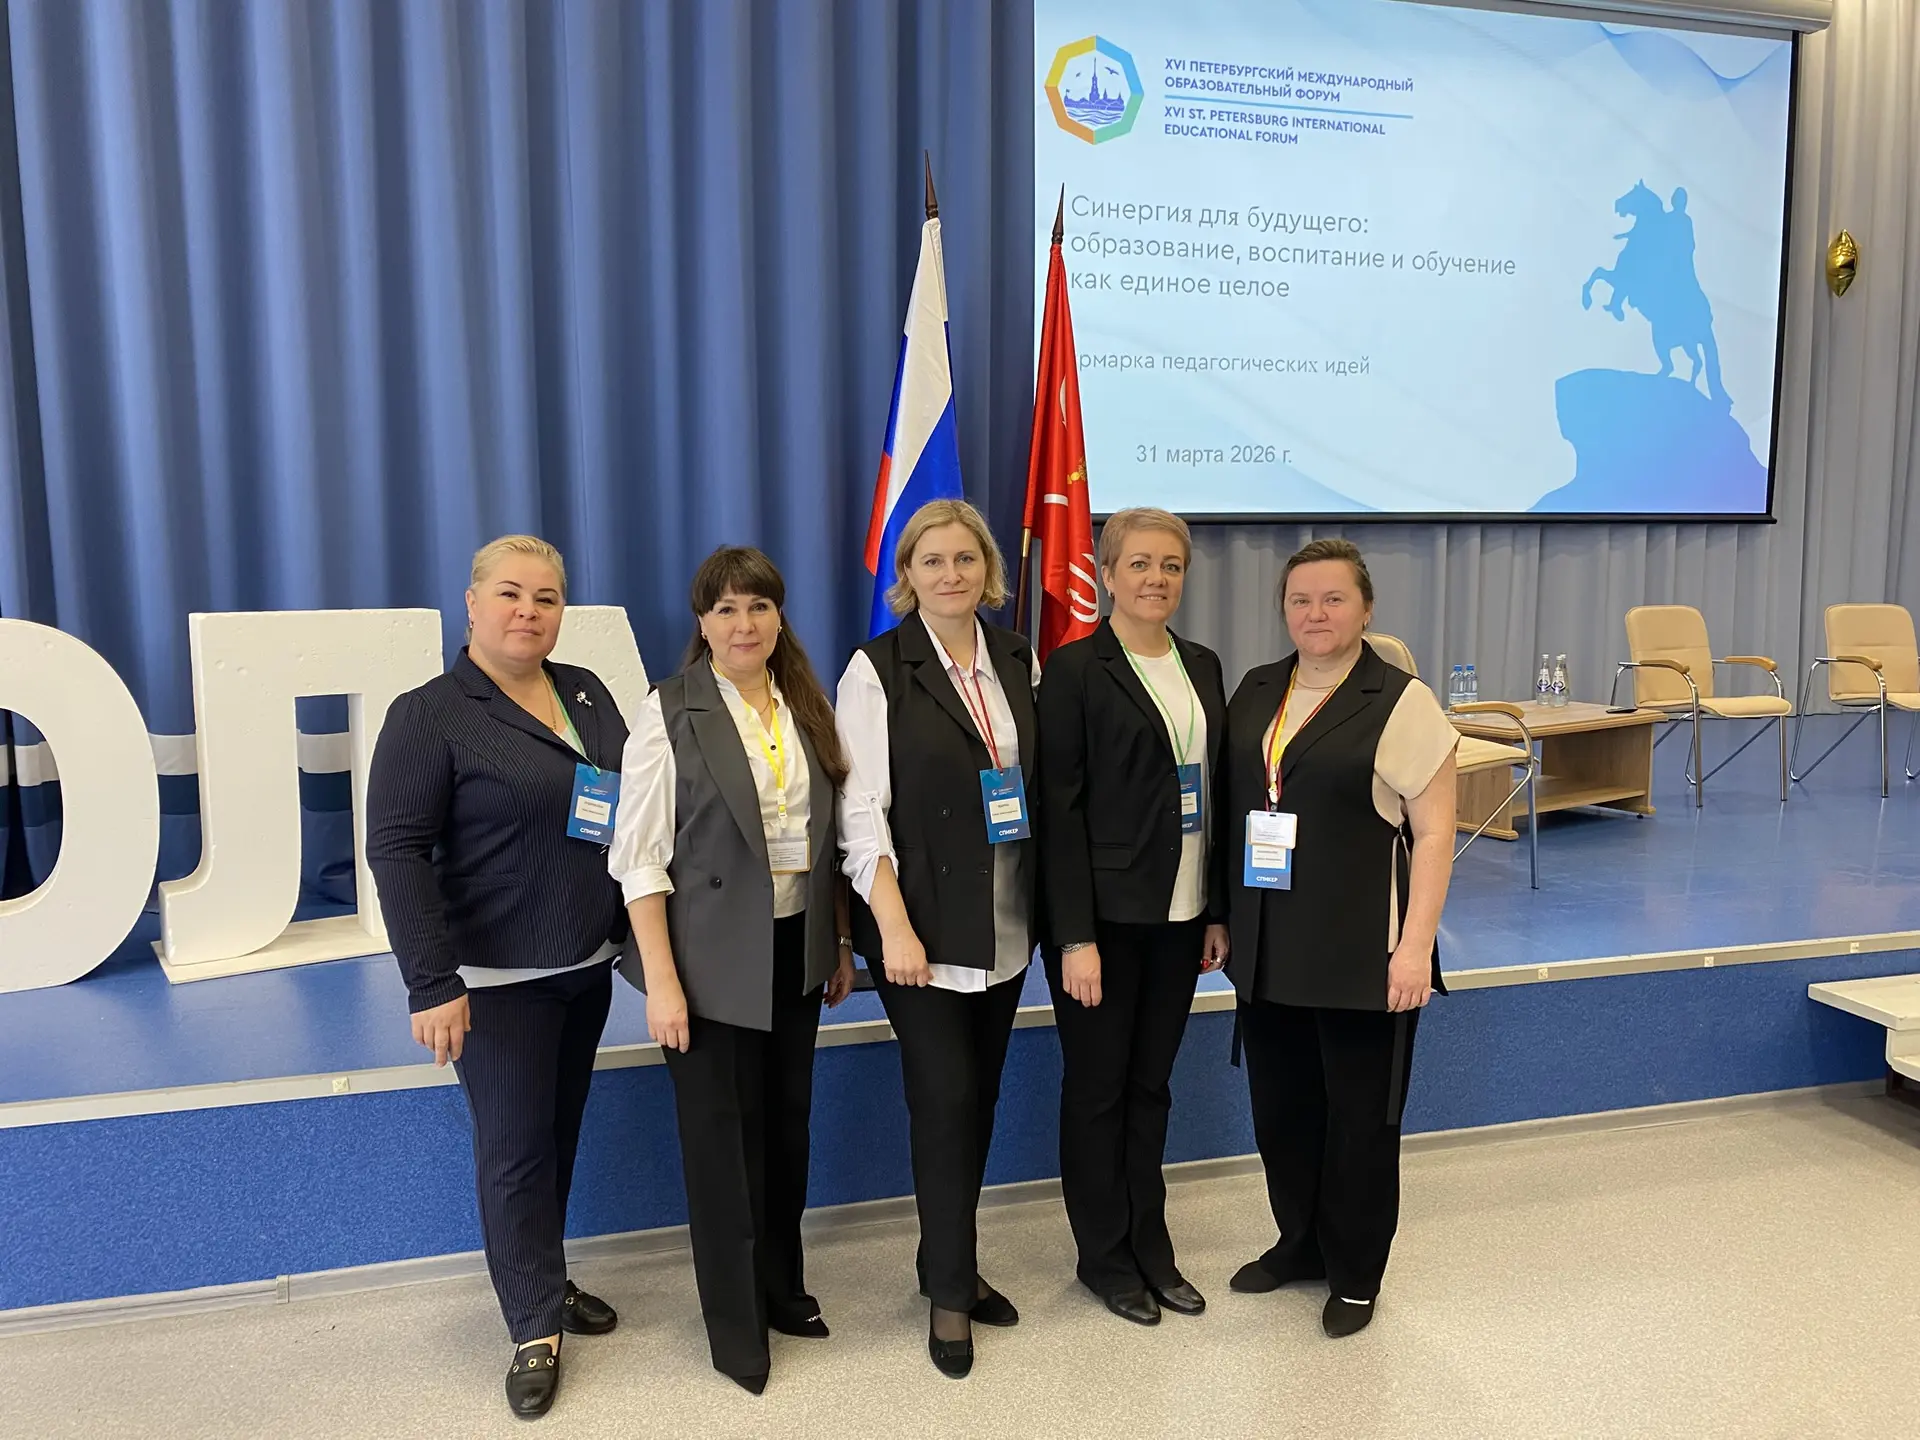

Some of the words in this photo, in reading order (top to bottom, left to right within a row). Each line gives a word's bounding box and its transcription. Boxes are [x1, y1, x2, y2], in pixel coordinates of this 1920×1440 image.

[1165, 58, 1185, 71] XVI
[1189, 61, 1293, 81] ПЕТЕРБУРГСКИЙ
[1298, 71, 1413, 92] МЕЖДУНАРОДНЫЙ
[1165, 76, 1292, 98] ОБРАЗОВАТЕЛЬНЫЙ
[1296, 88, 1340, 102] ФОРУМ
[1165, 106, 1184, 118] XVI
[1189, 108, 1205, 120] ST.
[1210, 109, 1289, 127] PETERSBURG
[1292, 116, 1386, 135] INTERNATIONAL
[1165, 124, 1252, 141] EDUCATIONAL
[1256, 131, 1298, 144] FORUM
[1071, 194, 1193, 226] Синергия
[1198, 208, 1240, 229] для
[1247, 205, 1369, 236] будущего:
[1070, 231, 1241, 266] образование,
[1248, 245, 1385, 268] воспитание
[1391, 253, 1404, 269] и
[1411, 250, 1516, 277] обучение
[1071, 271, 1112, 290] как
[1119, 274, 1211, 296] единое
[1218, 279, 1290, 298] целое
[1079, 353, 1155, 373] рмарка
[1162, 355, 1318, 373] педагогических
[1325, 355, 1370, 377] идей
[1136, 444, 1157, 463] 31
[1166, 448, 1224, 468] марта
[1230, 444, 1276, 463] 2026
[1282, 449, 1292, 464] г.
